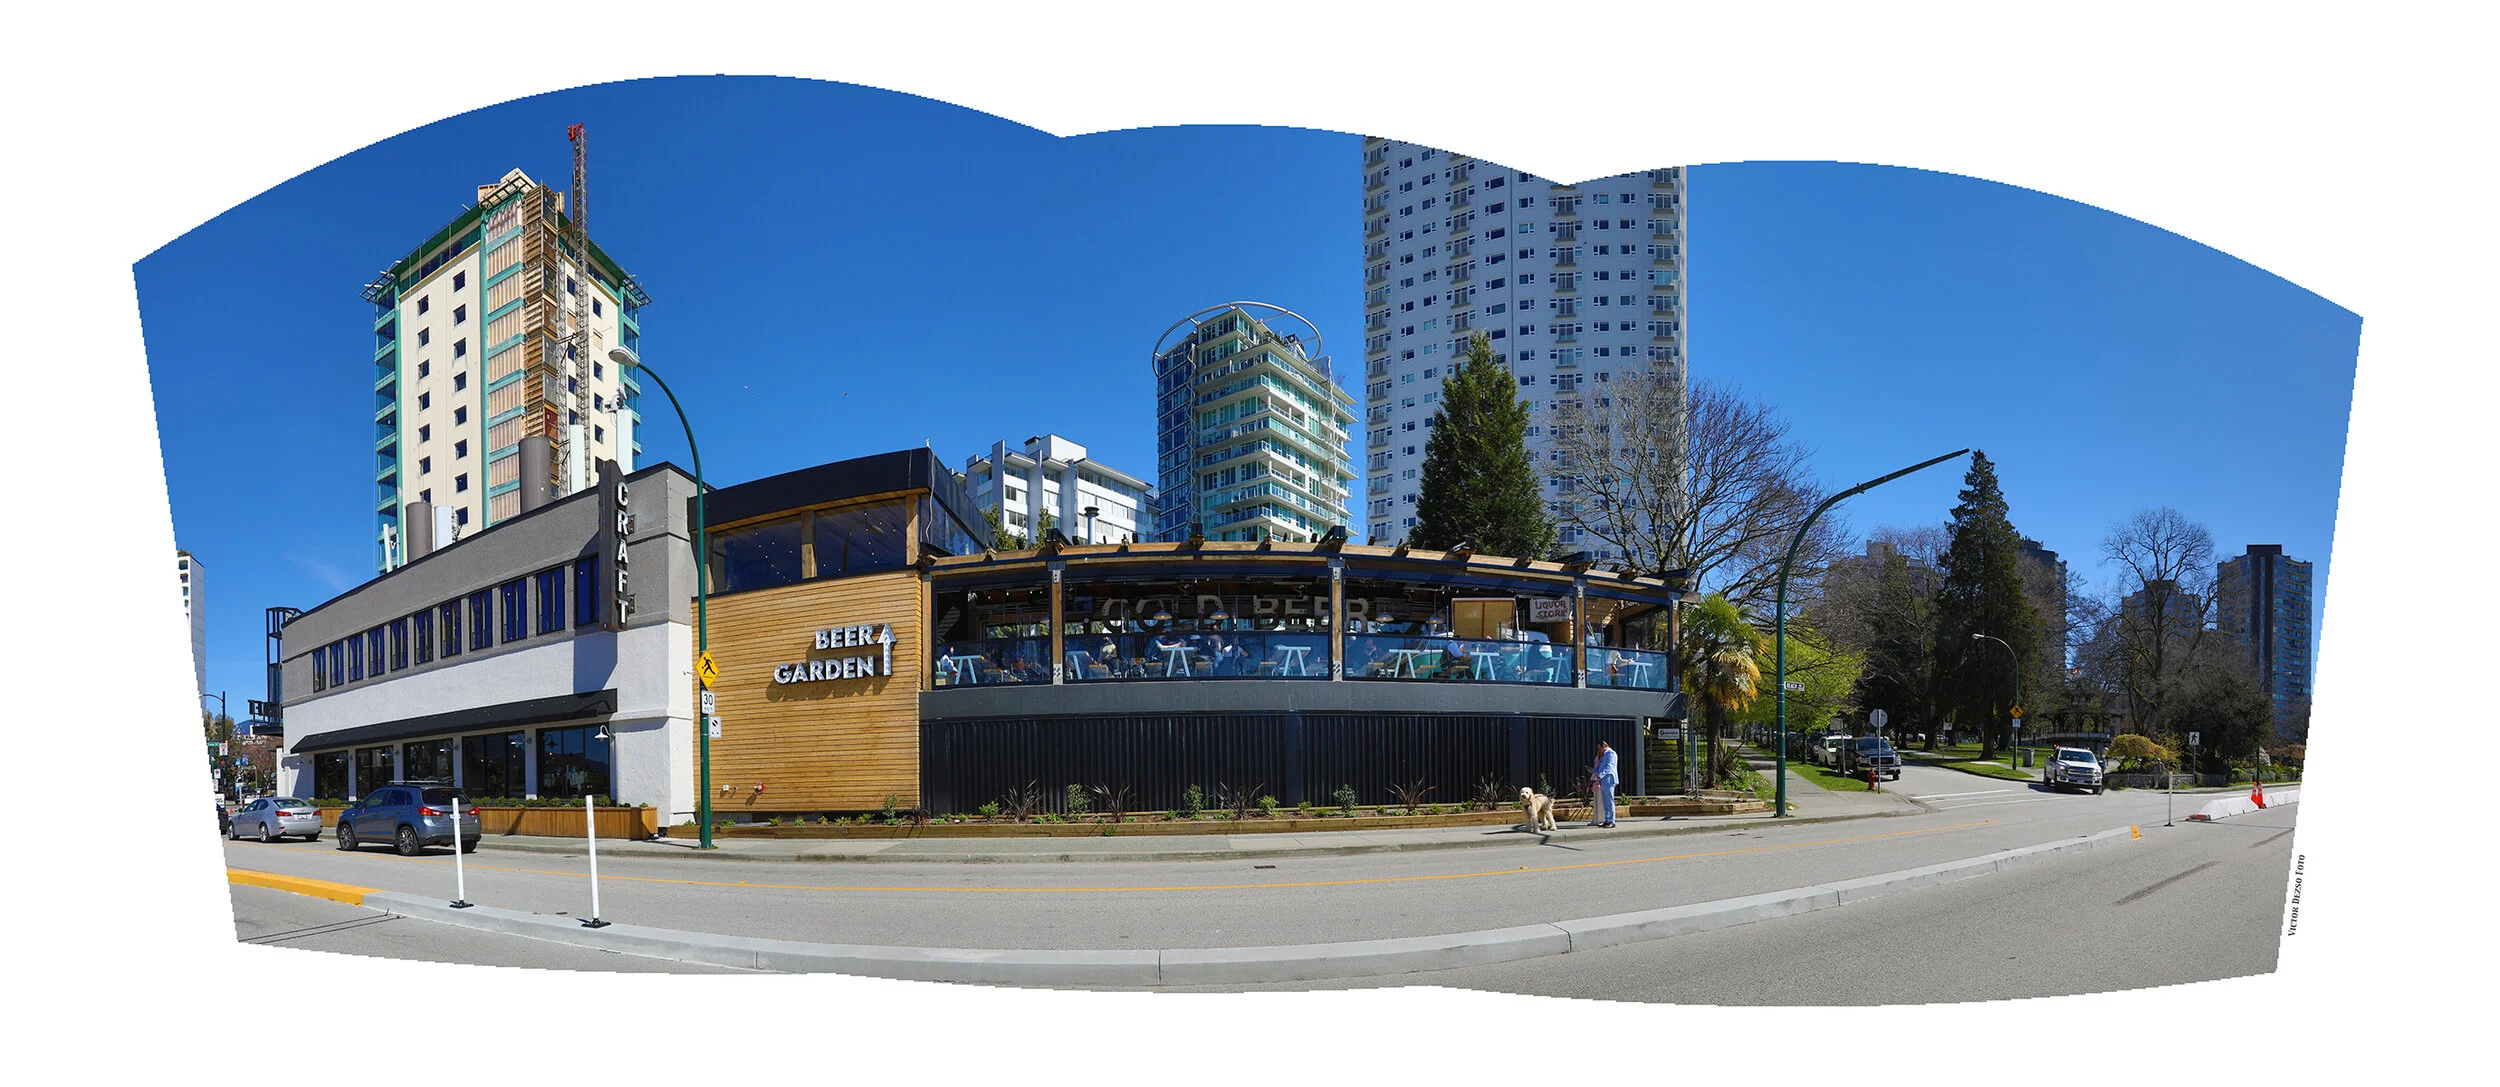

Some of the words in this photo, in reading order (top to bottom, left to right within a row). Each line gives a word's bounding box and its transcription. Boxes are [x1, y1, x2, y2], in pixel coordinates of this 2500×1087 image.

[616, 481, 629, 624] CRAFT
[1253, 596, 1369, 633] BEER
[1535, 600, 1567, 610] LIQUOR
[1536, 609, 1566, 619] STORE
[815, 624, 875, 650] BEER
[773, 655, 875, 684] GARDEN
[703, 693, 714, 706] 30
